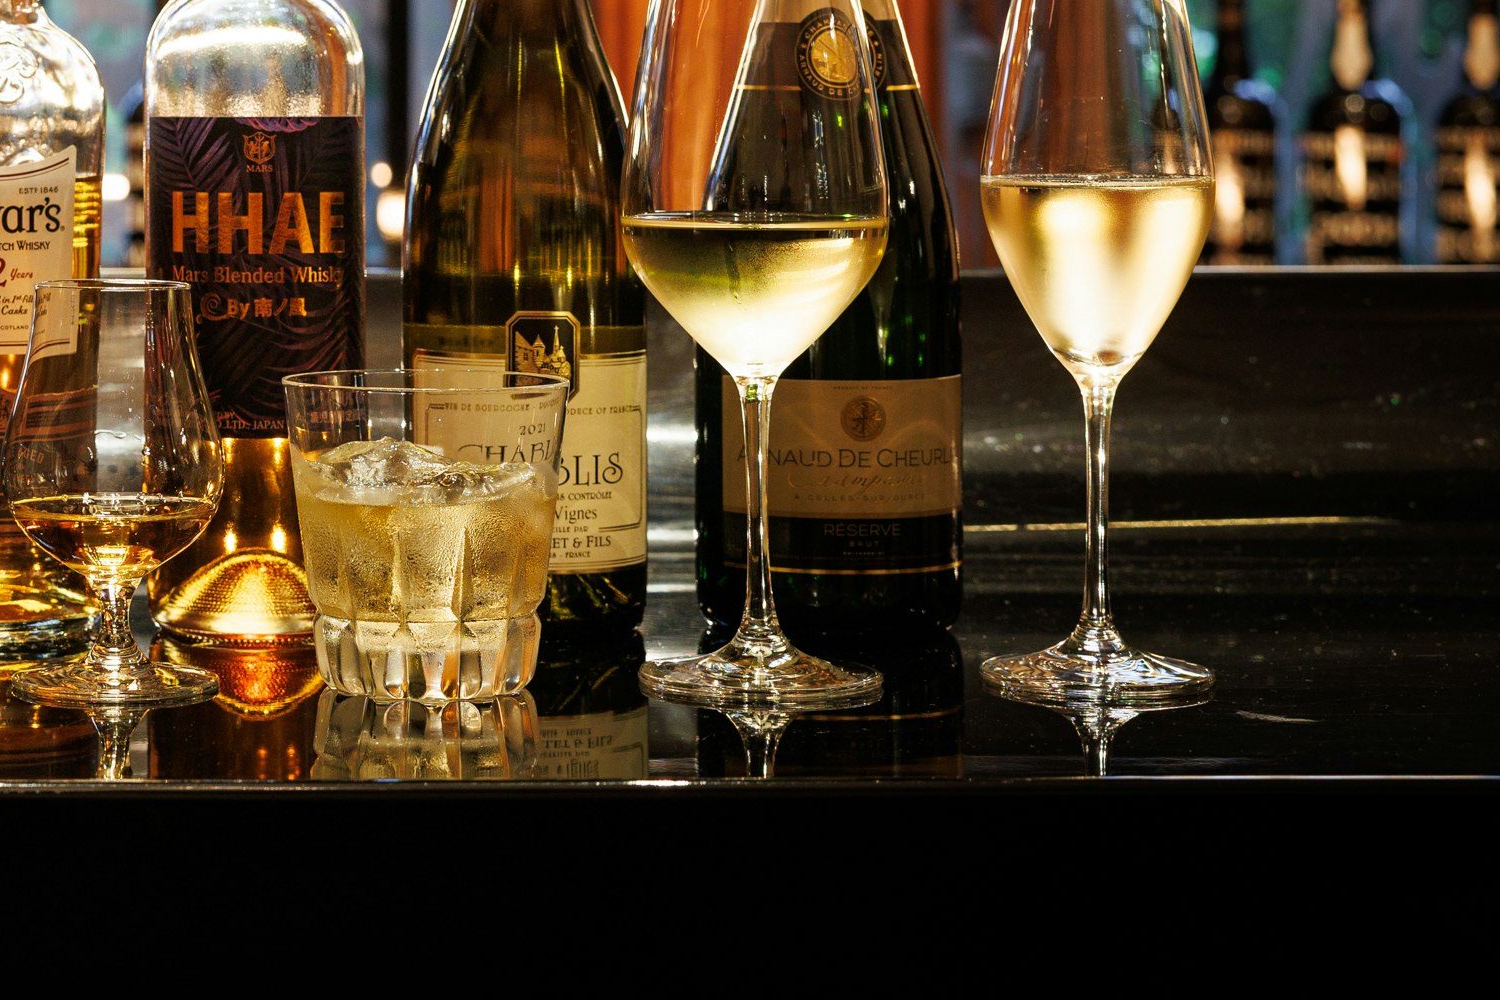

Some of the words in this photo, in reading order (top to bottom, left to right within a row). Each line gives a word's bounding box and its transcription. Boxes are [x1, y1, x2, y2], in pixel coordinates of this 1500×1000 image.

[246, 164, 274, 173] MARS
[40, 186, 59, 194] 1846
[171, 190, 346, 255] HHAE
[16, 240, 51, 251] WHISKY
[10, 268, 34, 281] Years
[172, 265, 209, 283] Mars
[214, 265, 285, 284] Blended
[2, 295, 11, 304] in
[1, 305, 28, 315] Casks
[227, 298, 251, 321] By
[461, 403, 473, 411] DE
[475, 403, 530, 412] BOURGOGNE
[595, 407, 607, 415] OF
[609, 405, 634, 414] FRANCE
[252, 419, 285, 430] JAPAN
[518, 423, 546, 436] 2021
[736, 448, 833, 468] ANAUD
[838, 448, 872, 468] DE
[876, 448, 952, 468] CHEURL
[554, 505, 598, 525] Vignes
[823, 521, 901, 537] RÉSERVE
[551, 537, 570, 549] ET
[572, 537, 583, 549] &
[585, 535, 613, 549] FILS
[565, 551, 591, 559] FRANCE
